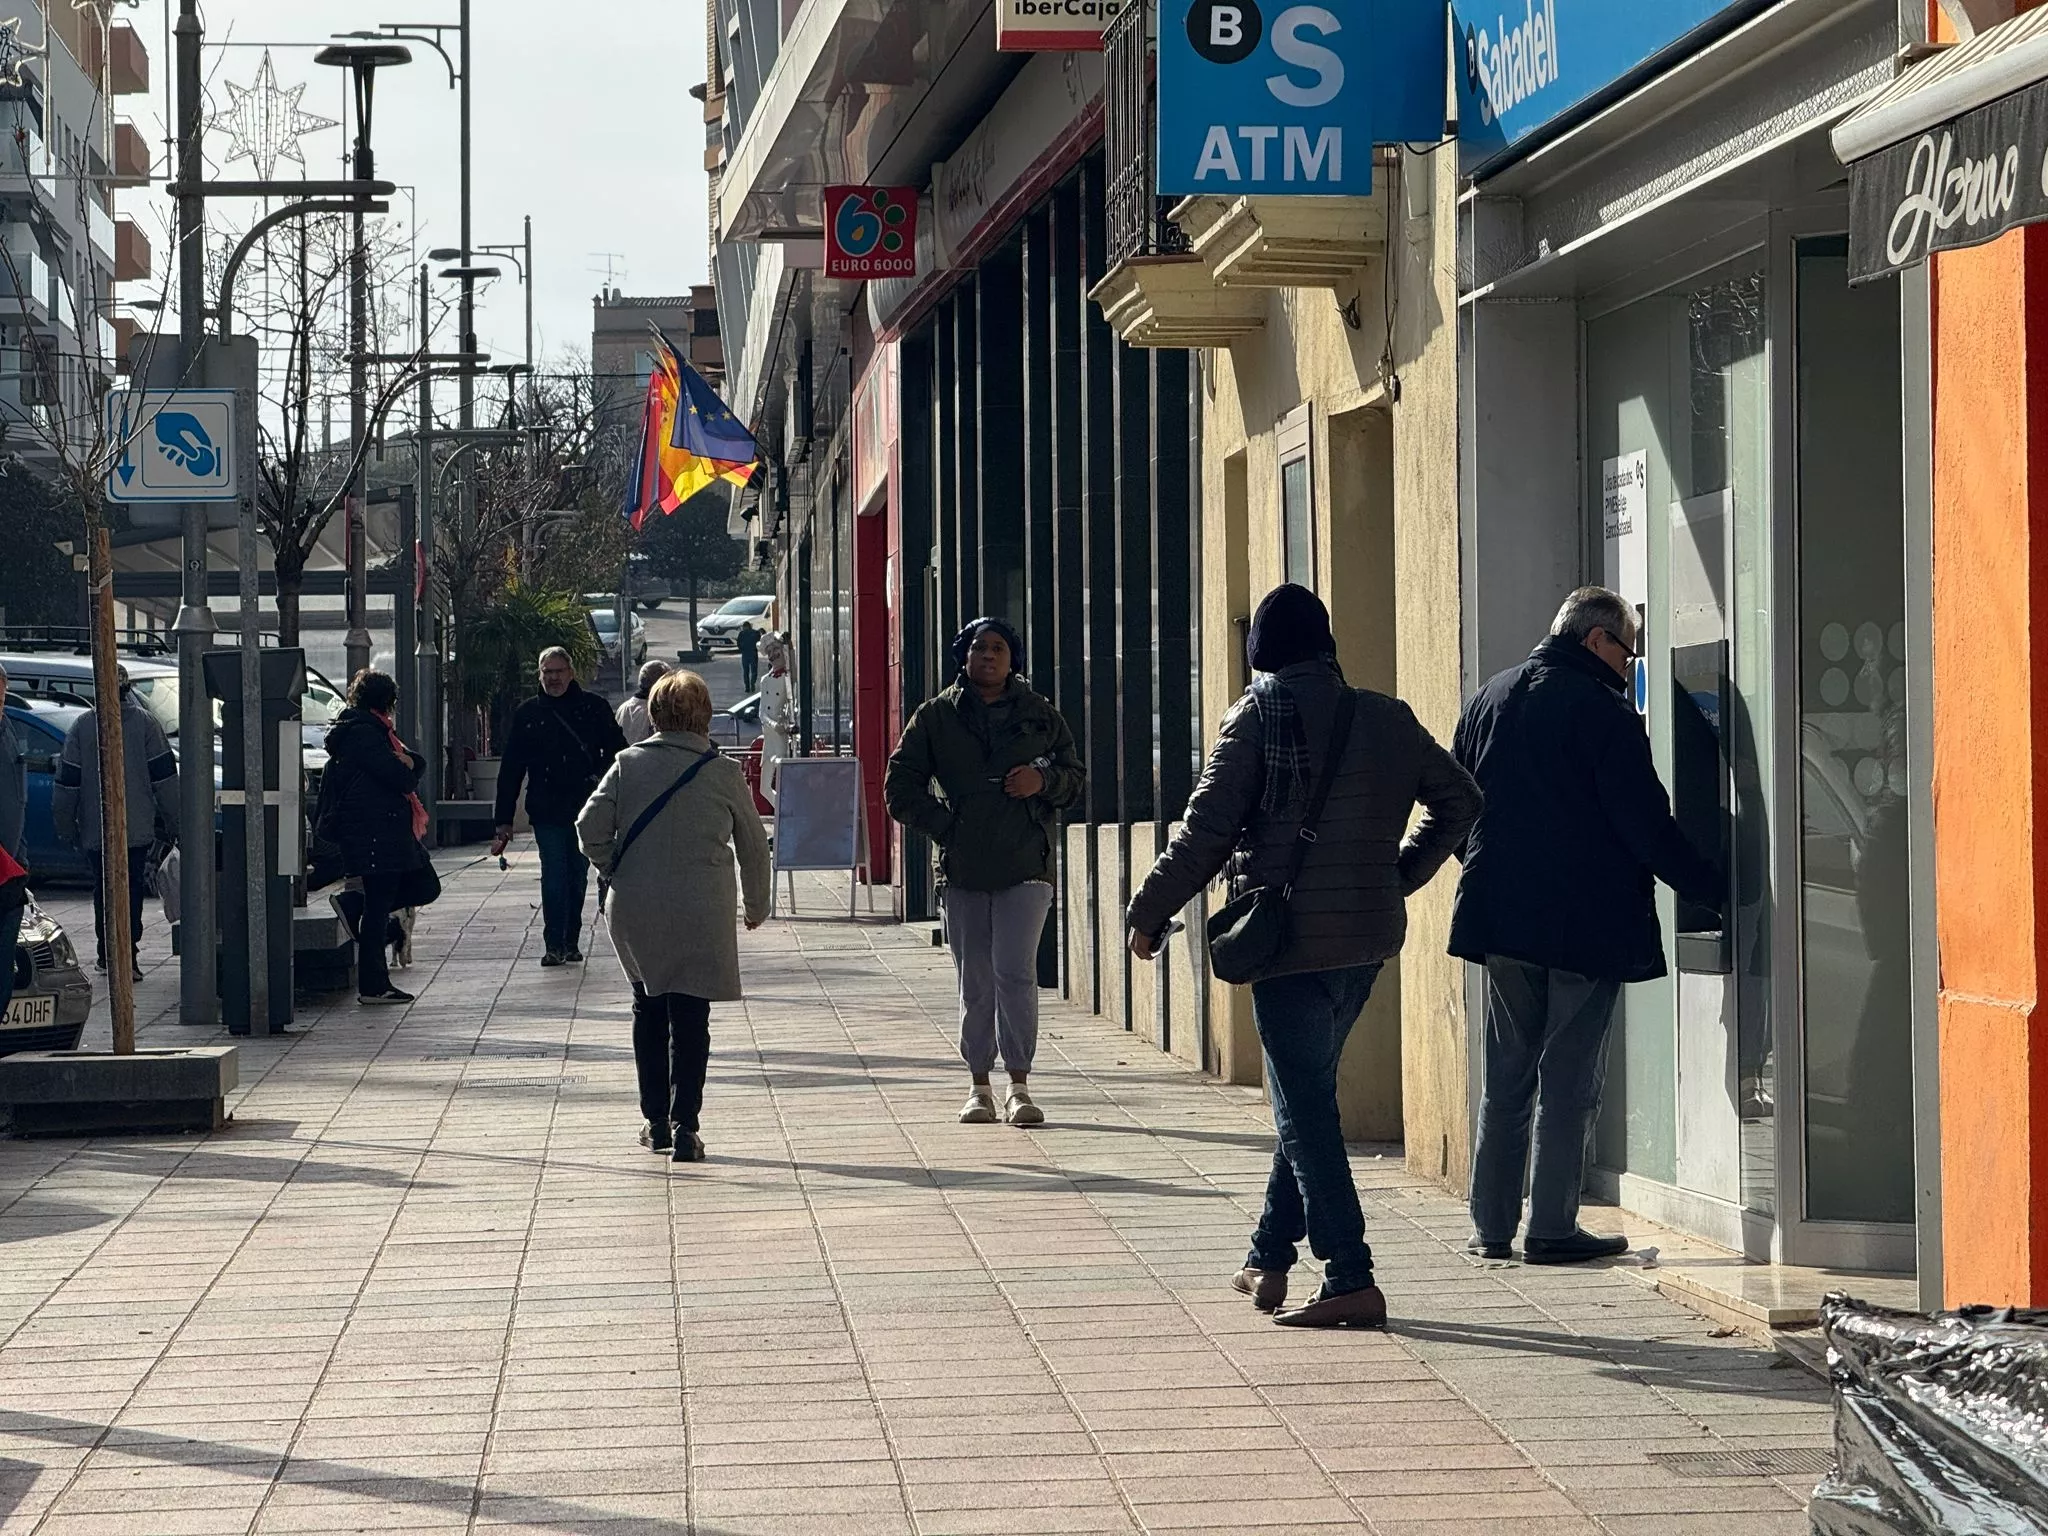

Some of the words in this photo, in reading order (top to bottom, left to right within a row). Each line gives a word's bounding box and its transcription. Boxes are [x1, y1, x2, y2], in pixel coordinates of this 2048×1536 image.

[1477, 0, 1559, 126] Sabadell
[1193, 125, 1343, 182] ATM
[1886, 131, 2018, 265] Horno
[831, 258, 870, 273] EURO
[873, 258, 914, 272] 6000
[24, 1000, 51, 1024] DHF
